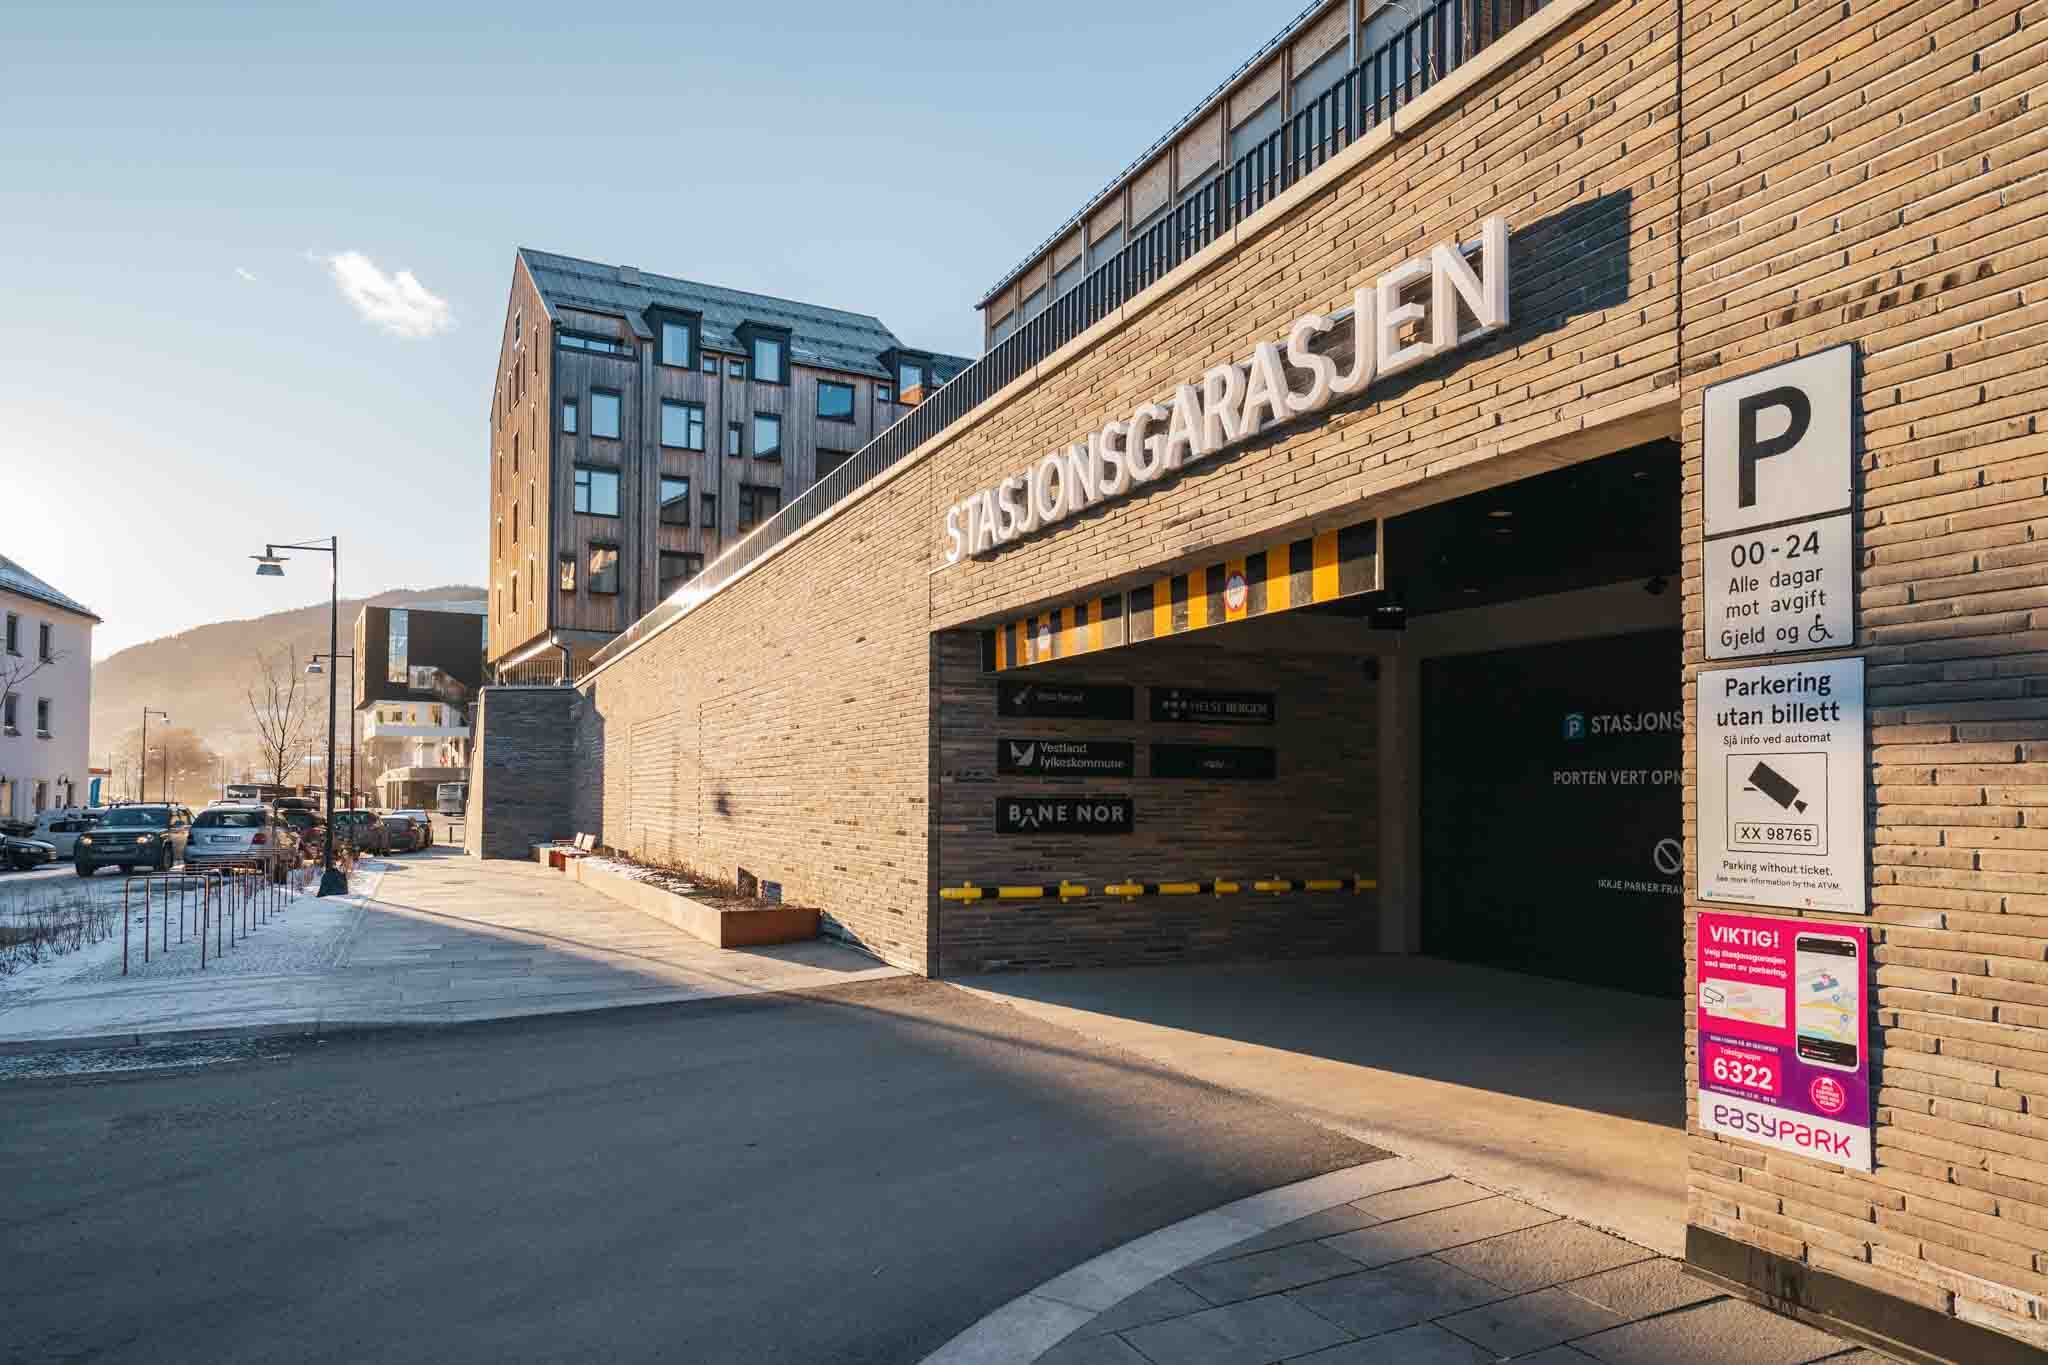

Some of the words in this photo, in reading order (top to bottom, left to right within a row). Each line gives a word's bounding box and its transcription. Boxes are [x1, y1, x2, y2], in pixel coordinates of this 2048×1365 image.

[945, 215, 1510, 563] STASJONSGARASJEN
[1738, 386, 1811, 508] P
[1728, 574, 1759, 595] Alle
[1769, 567, 1823, 592] dagar
[1726, 600, 1760, 619] mot
[1770, 589, 1826, 617] avgift
[1720, 625, 1765, 650] Gjeld
[1776, 625, 1799, 643] og
[1725, 671, 1831, 697] Parkering
[1717, 708, 1763, 727] utan
[1772, 702, 1840, 725] billett
[1040, 742, 1087, 753] Vestland
[1723, 734, 1737, 747] Sjå
[1740, 733, 1760, 745] info
[1763, 734, 1782, 745] ved
[1784, 732, 1831, 744] automat
[1040, 756, 1126, 769] fylkeskommune
[1553, 771, 1609, 785] PORTEN
[1610, 770, 1647, 785] VERT
[1076, 805, 1125, 823] NOR
[1741, 826, 1761, 840] XX
[1767, 827, 1812, 842] 98765
[1723, 860, 1757, 873] Parking
[1760, 862, 1797, 873] without
[1799, 864, 1833, 876] ticket.
[1749, 876, 1791, 886] information
[1792, 880, 1802, 888] by
[1803, 880, 1816, 888] the
[1710, 925, 1779, 949] VIKTIG!
[1704, 947, 1721, 958] Velg
[1713, 1057, 1773, 1090] 6322
